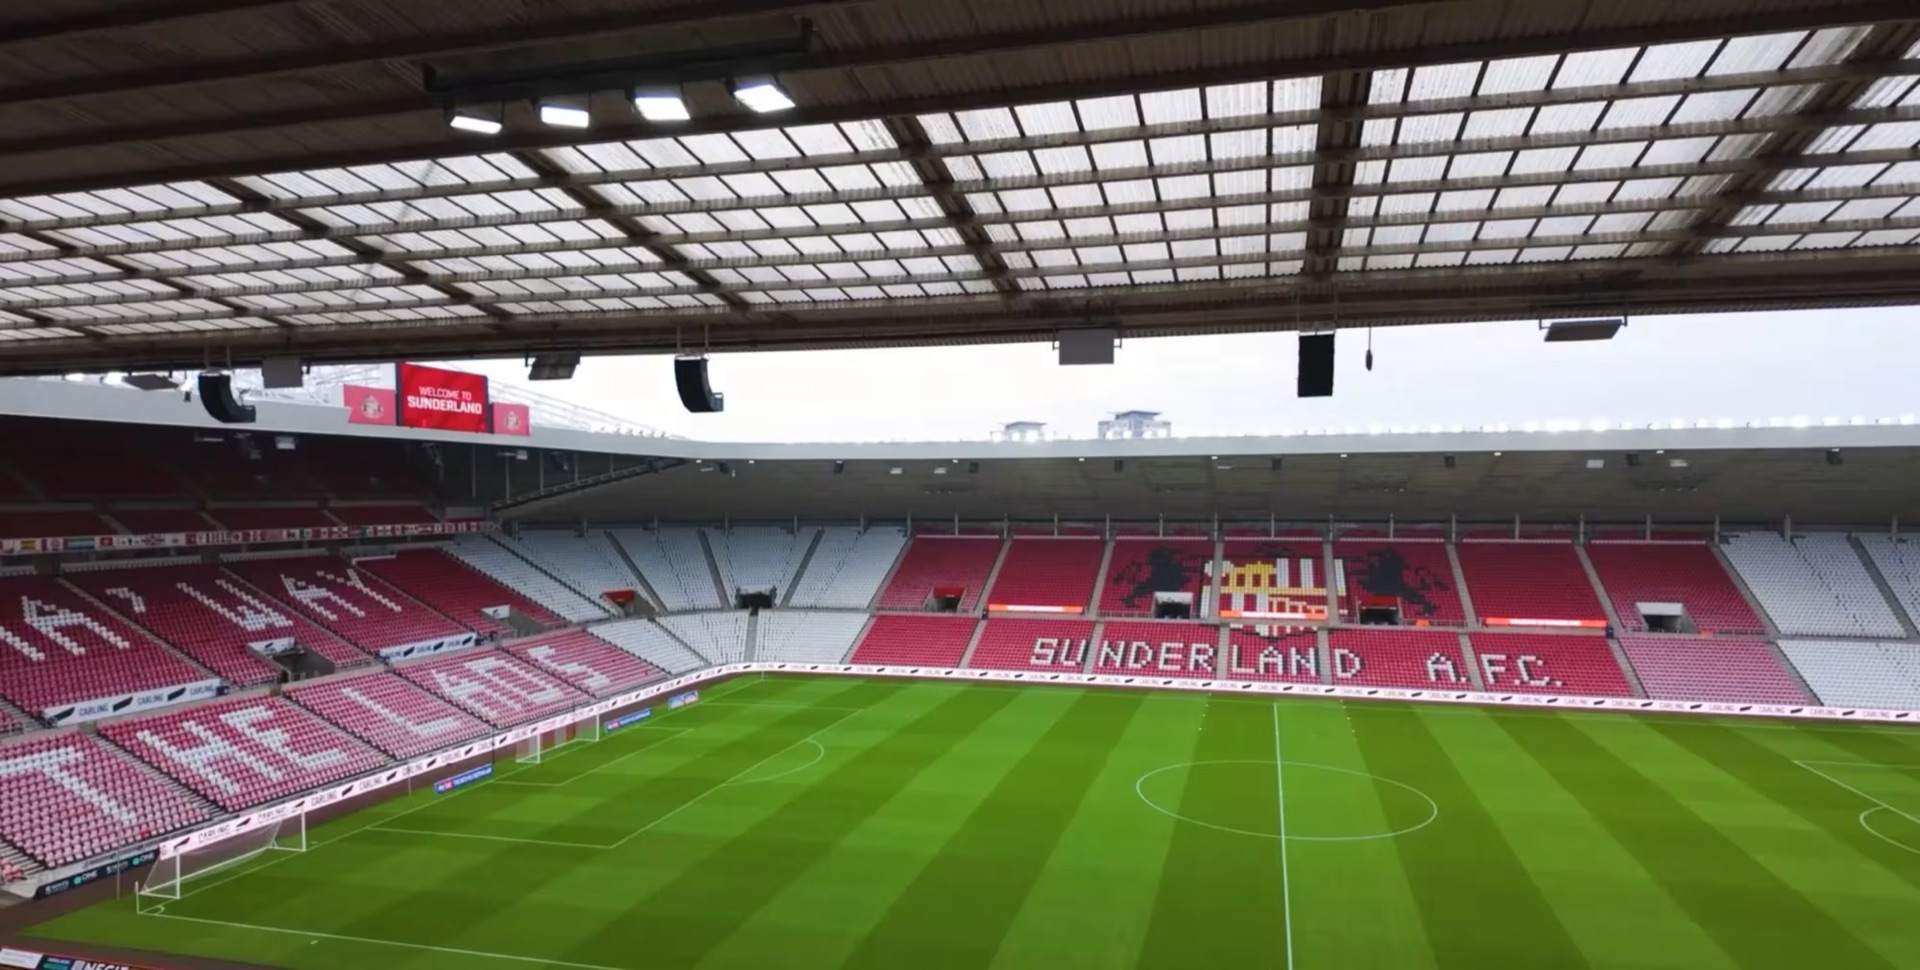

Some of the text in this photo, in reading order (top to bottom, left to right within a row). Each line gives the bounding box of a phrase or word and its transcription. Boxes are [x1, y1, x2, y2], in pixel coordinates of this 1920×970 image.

[407, 395, 483, 415] SUNDERLAND
[419, 386, 472, 400] WELCOME TO
[1029, 636, 1362, 678] SUNDERLAND
[79, 685, 215, 717] CARLING CARLING CARLING
[0, 705, 345, 824] THE
